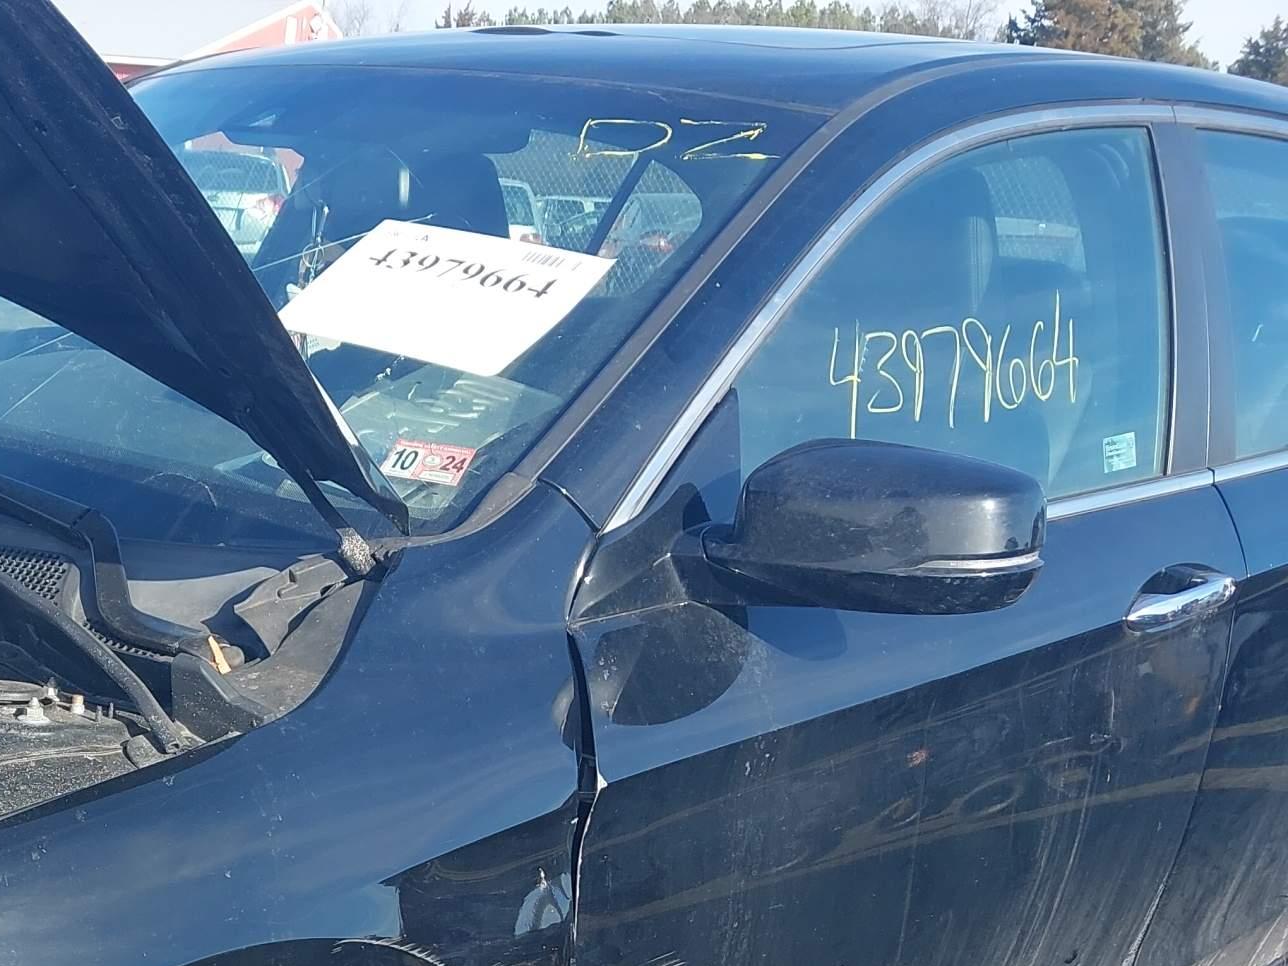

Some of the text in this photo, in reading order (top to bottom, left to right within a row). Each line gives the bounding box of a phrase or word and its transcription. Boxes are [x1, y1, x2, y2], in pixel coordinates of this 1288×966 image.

[369, 248, 558, 299] 43979664
[829, 289, 1080, 440] 43979664
[391, 448, 468, 474] 10 24
